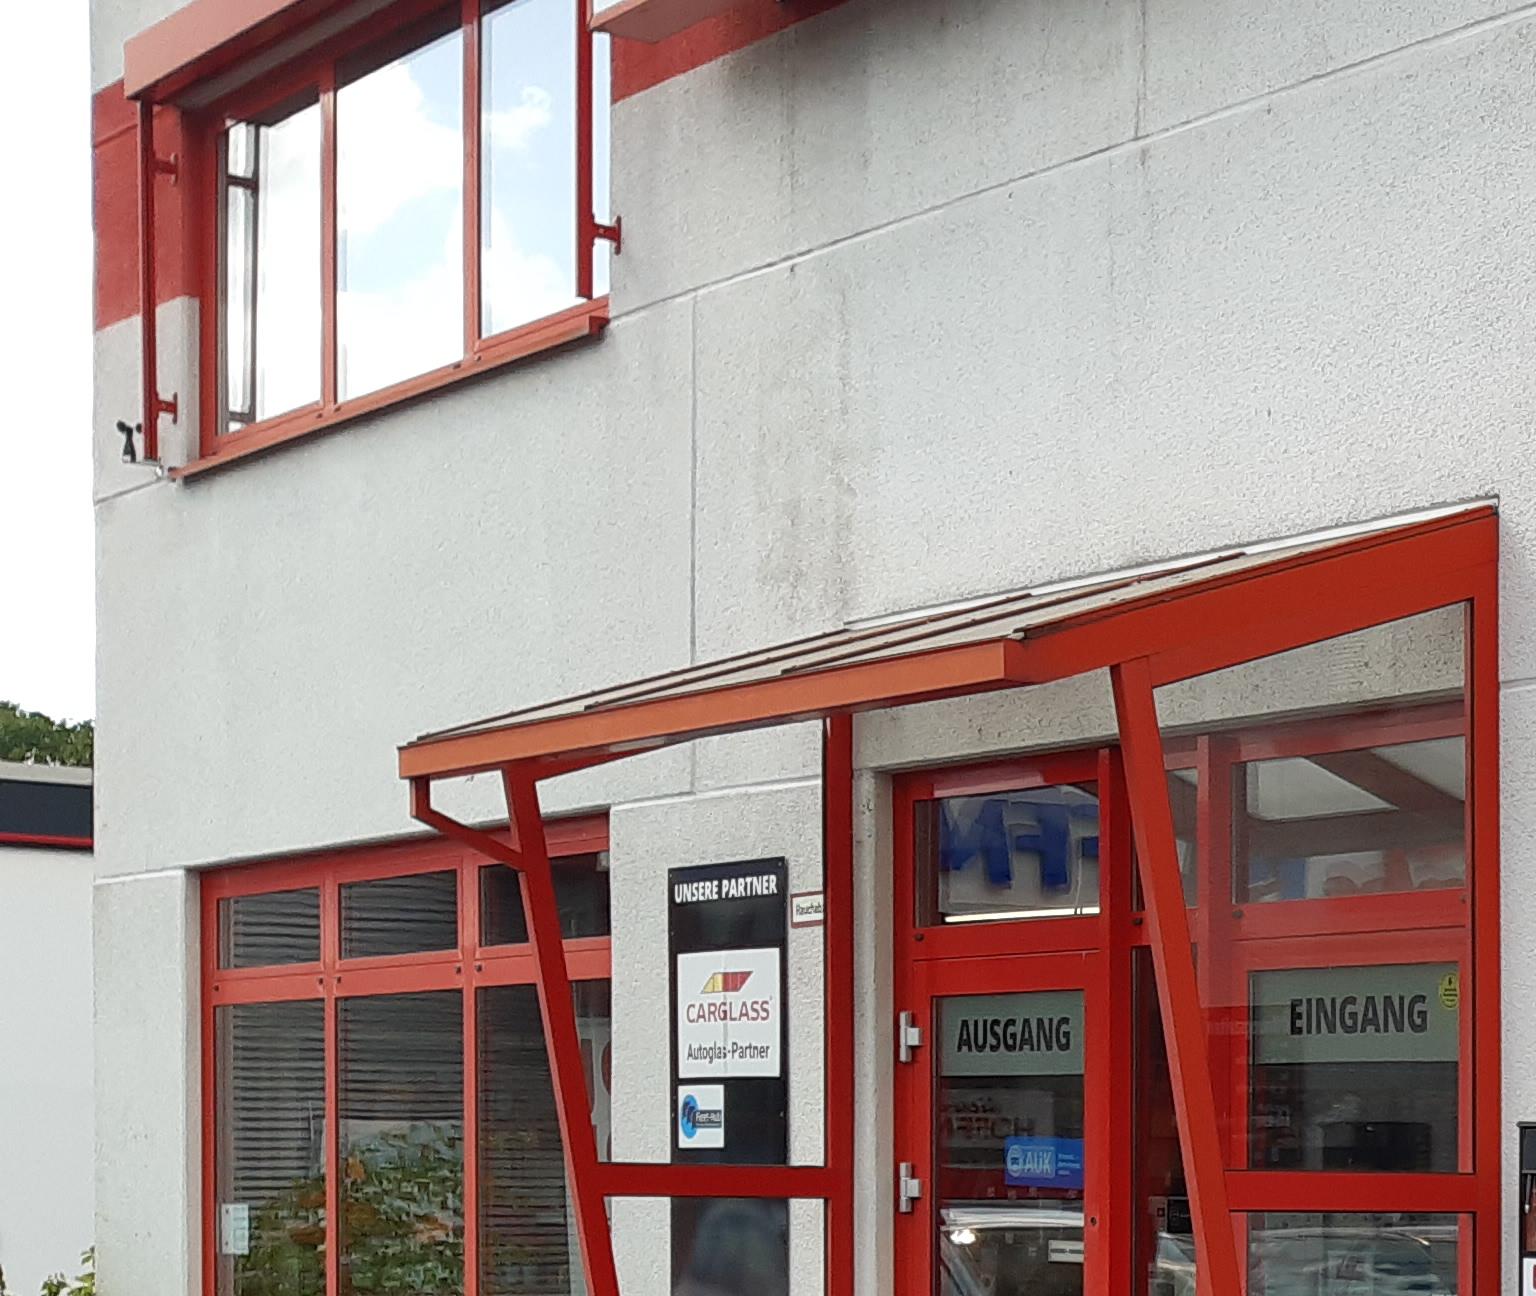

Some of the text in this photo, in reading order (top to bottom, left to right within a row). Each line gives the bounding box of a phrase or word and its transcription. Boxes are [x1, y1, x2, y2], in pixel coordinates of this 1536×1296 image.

[674, 874, 778, 904] UNSERE PARTNER
[686, 1000, 770, 1024] CARGLASS
[1289, 993, 1429, 1036] EINGANG
[956, 1015, 1072, 1054] AUSGANG
[686, 1041, 771, 1065] Autoglas-Partner
